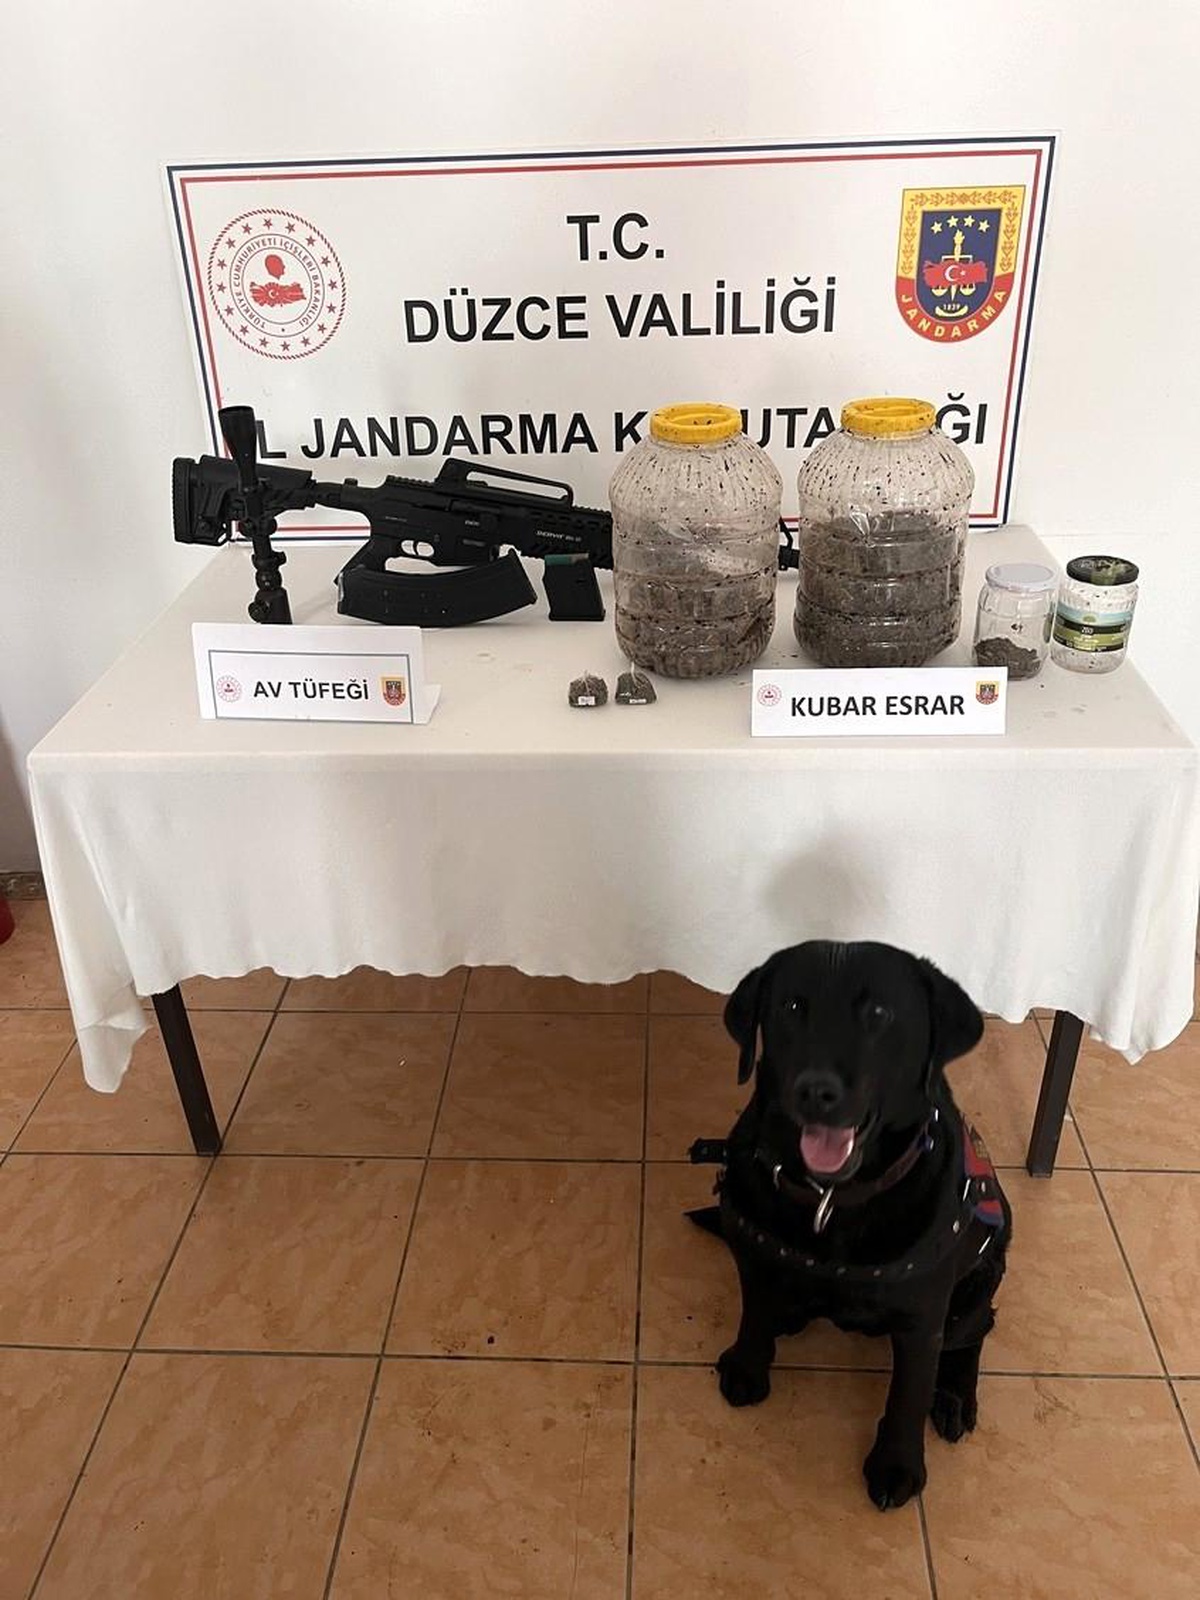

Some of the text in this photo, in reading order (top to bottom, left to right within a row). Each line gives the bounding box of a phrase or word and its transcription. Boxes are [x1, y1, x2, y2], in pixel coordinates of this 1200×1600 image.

[566, 212, 665, 261] T.C.
[403, 276, 837, 343] DÜZCE VALİLİĞİ
[901, 290, 1007, 338] JANDARMA
[256, 392, 989, 459] L JANDARMA KUTAĞI
[253, 678, 369, 700] AV TÜFEĞİ
[791, 695, 966, 717] KUBAR ESRAR
